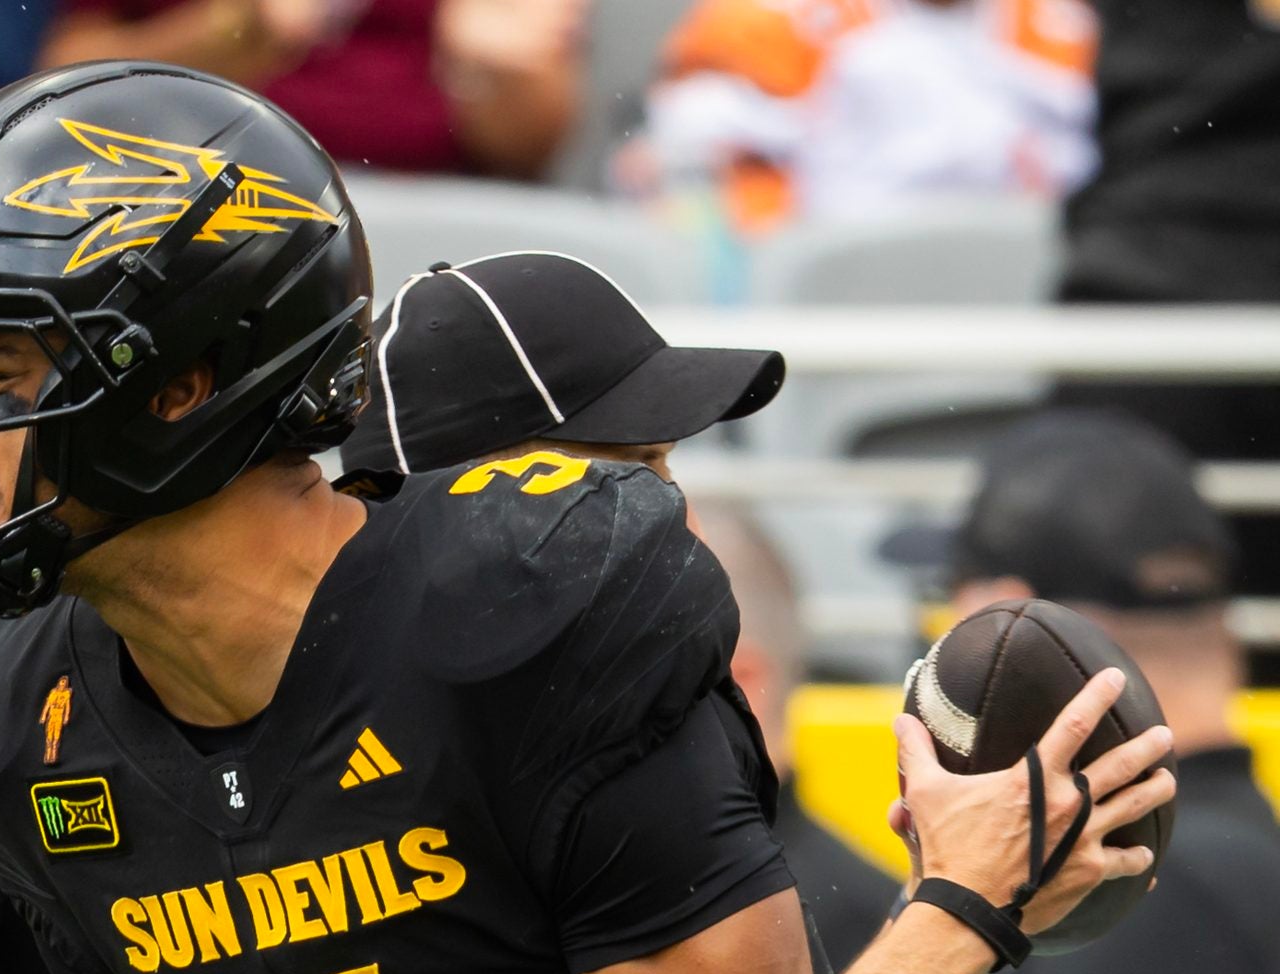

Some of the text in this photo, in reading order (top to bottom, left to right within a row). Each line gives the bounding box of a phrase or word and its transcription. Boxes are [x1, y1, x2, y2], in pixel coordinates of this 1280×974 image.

[448, 450, 592, 495] 3
[222, 770, 238, 788] PT
[229, 792, 245, 809] 42
[111, 827, 467, 973] SUN DEVILS
